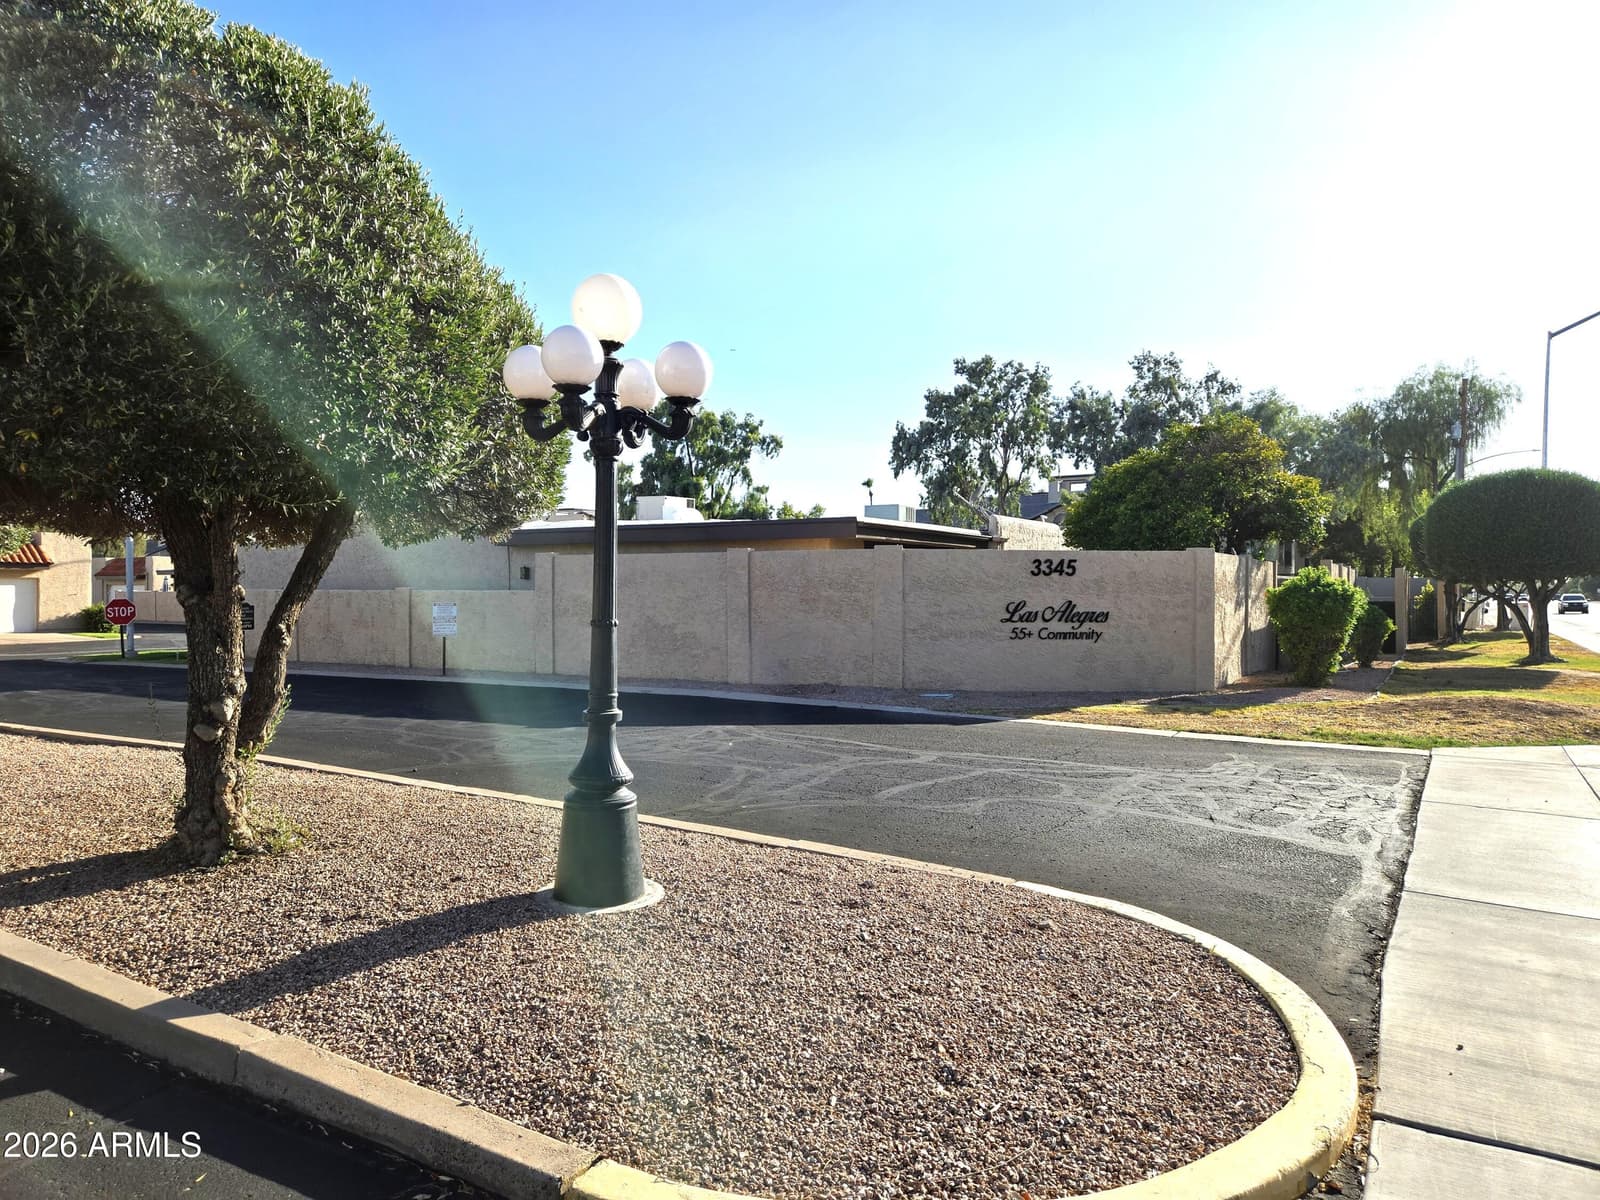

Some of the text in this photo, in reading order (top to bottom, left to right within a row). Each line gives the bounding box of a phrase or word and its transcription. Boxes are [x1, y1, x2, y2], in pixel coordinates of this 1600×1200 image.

[1030, 558, 1077, 577] 3345
[107, 606, 134, 618] STOP
[1000, 600, 1110, 630] Las Alegres
[1009, 627, 1103, 643] 55+ Community
